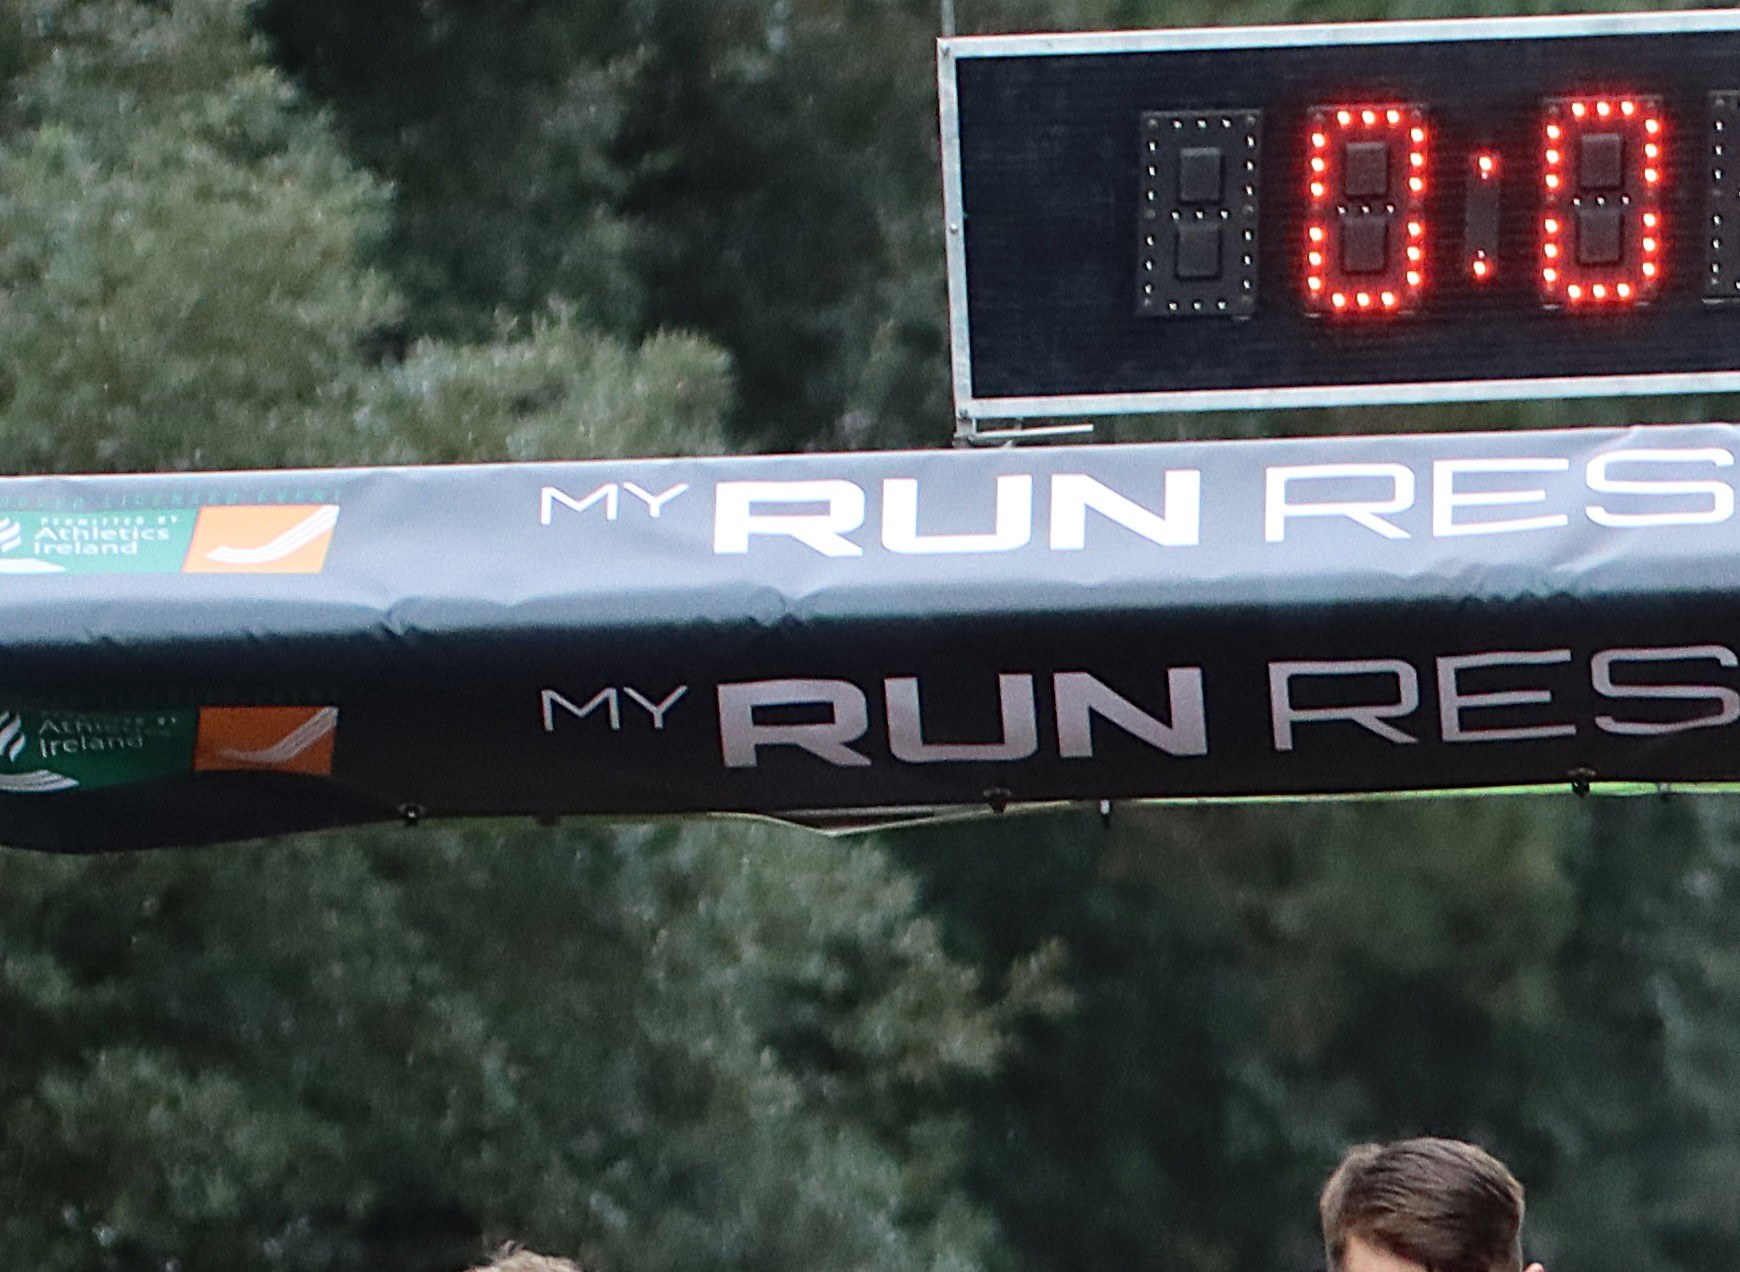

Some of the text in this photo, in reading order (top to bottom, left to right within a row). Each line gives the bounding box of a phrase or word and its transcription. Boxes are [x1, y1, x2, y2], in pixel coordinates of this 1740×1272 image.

[540, 481, 690, 526] MY
[713, 468, 1202, 558] RUN
[34, 524, 170, 542] Athletics
[33, 539, 139, 556] Ireland
[541, 685, 689, 732] MY
[715, 666, 1210, 769] RUN
[39, 733, 145, 759] Ireland
